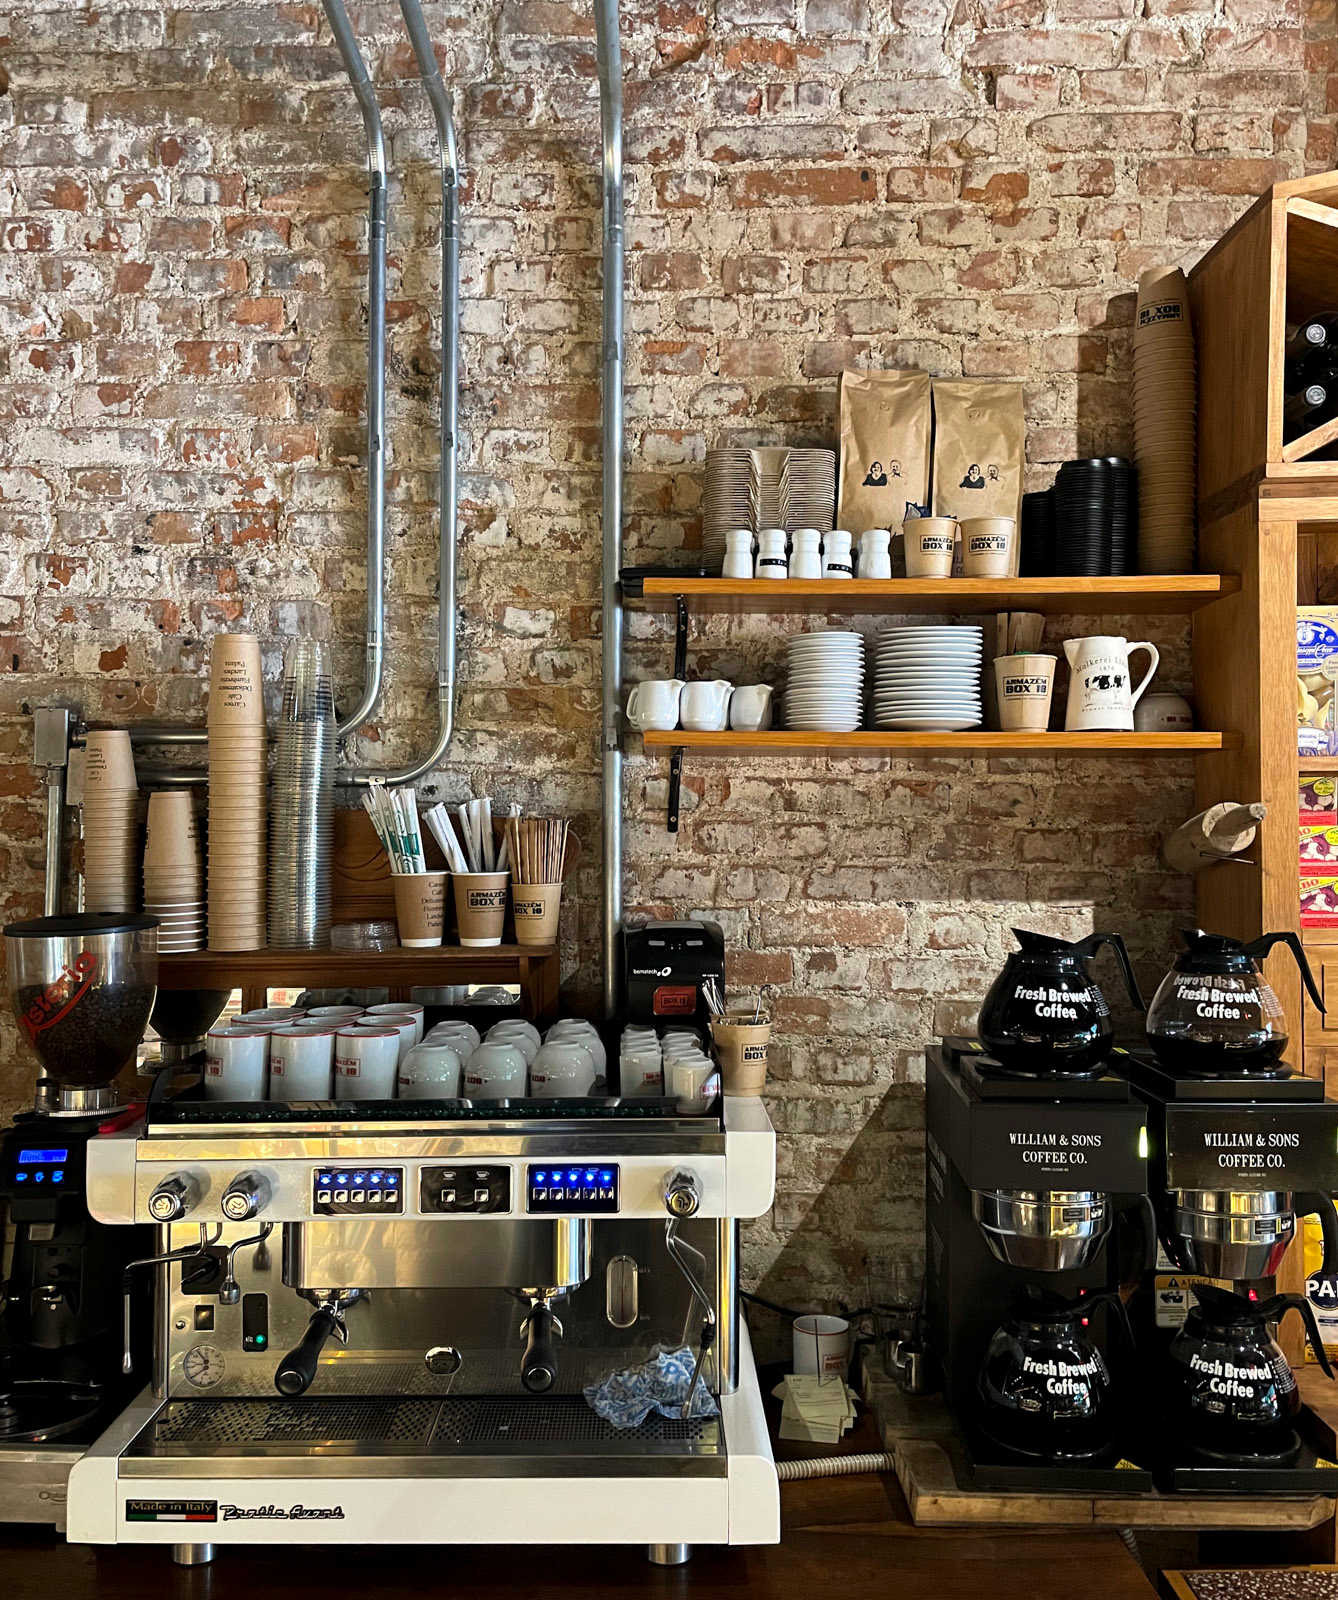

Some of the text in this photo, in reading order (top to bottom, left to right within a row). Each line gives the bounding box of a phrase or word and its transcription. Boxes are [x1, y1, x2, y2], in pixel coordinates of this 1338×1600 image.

[922, 542, 943, 550] BOX
[971, 541, 993, 550] BOX
[1005, 684, 1031, 694] BOX
[471, 898, 496, 906] BOX
[1014, 985, 1047, 1001] Fresh
[1048, 987, 1092, 1003] Brewed
[1177, 985, 1209, 1001] Fresh
[1211, 988, 1258, 1004] Brewed
[1035, 1002, 1078, 1019] Coffee
[1196, 1002, 1241, 1019] Coffee
[745, 1052, 763, 1060] BOX
[1009, 1133, 1102, 1147] WILLIAM & SONS
[1204, 1133, 1300, 1147] WILLIAM & SONS
[1022, 1150, 1088, 1165] COFFEE CO.
[1218, 1154, 1286, 1168] COFFEE CO.
[1023, 1356, 1057, 1376] Fresh
[1058, 1356, 1098, 1377] Brewed
[1190, 1353, 1223, 1376] Fresh
[1224, 1362, 1272, 1380] Brewed
[1046, 1377, 1087, 1396] Coffee
[1209, 1377, 1254, 1398] Coffee
[130, 1502, 213, 1513] Made in Italy
